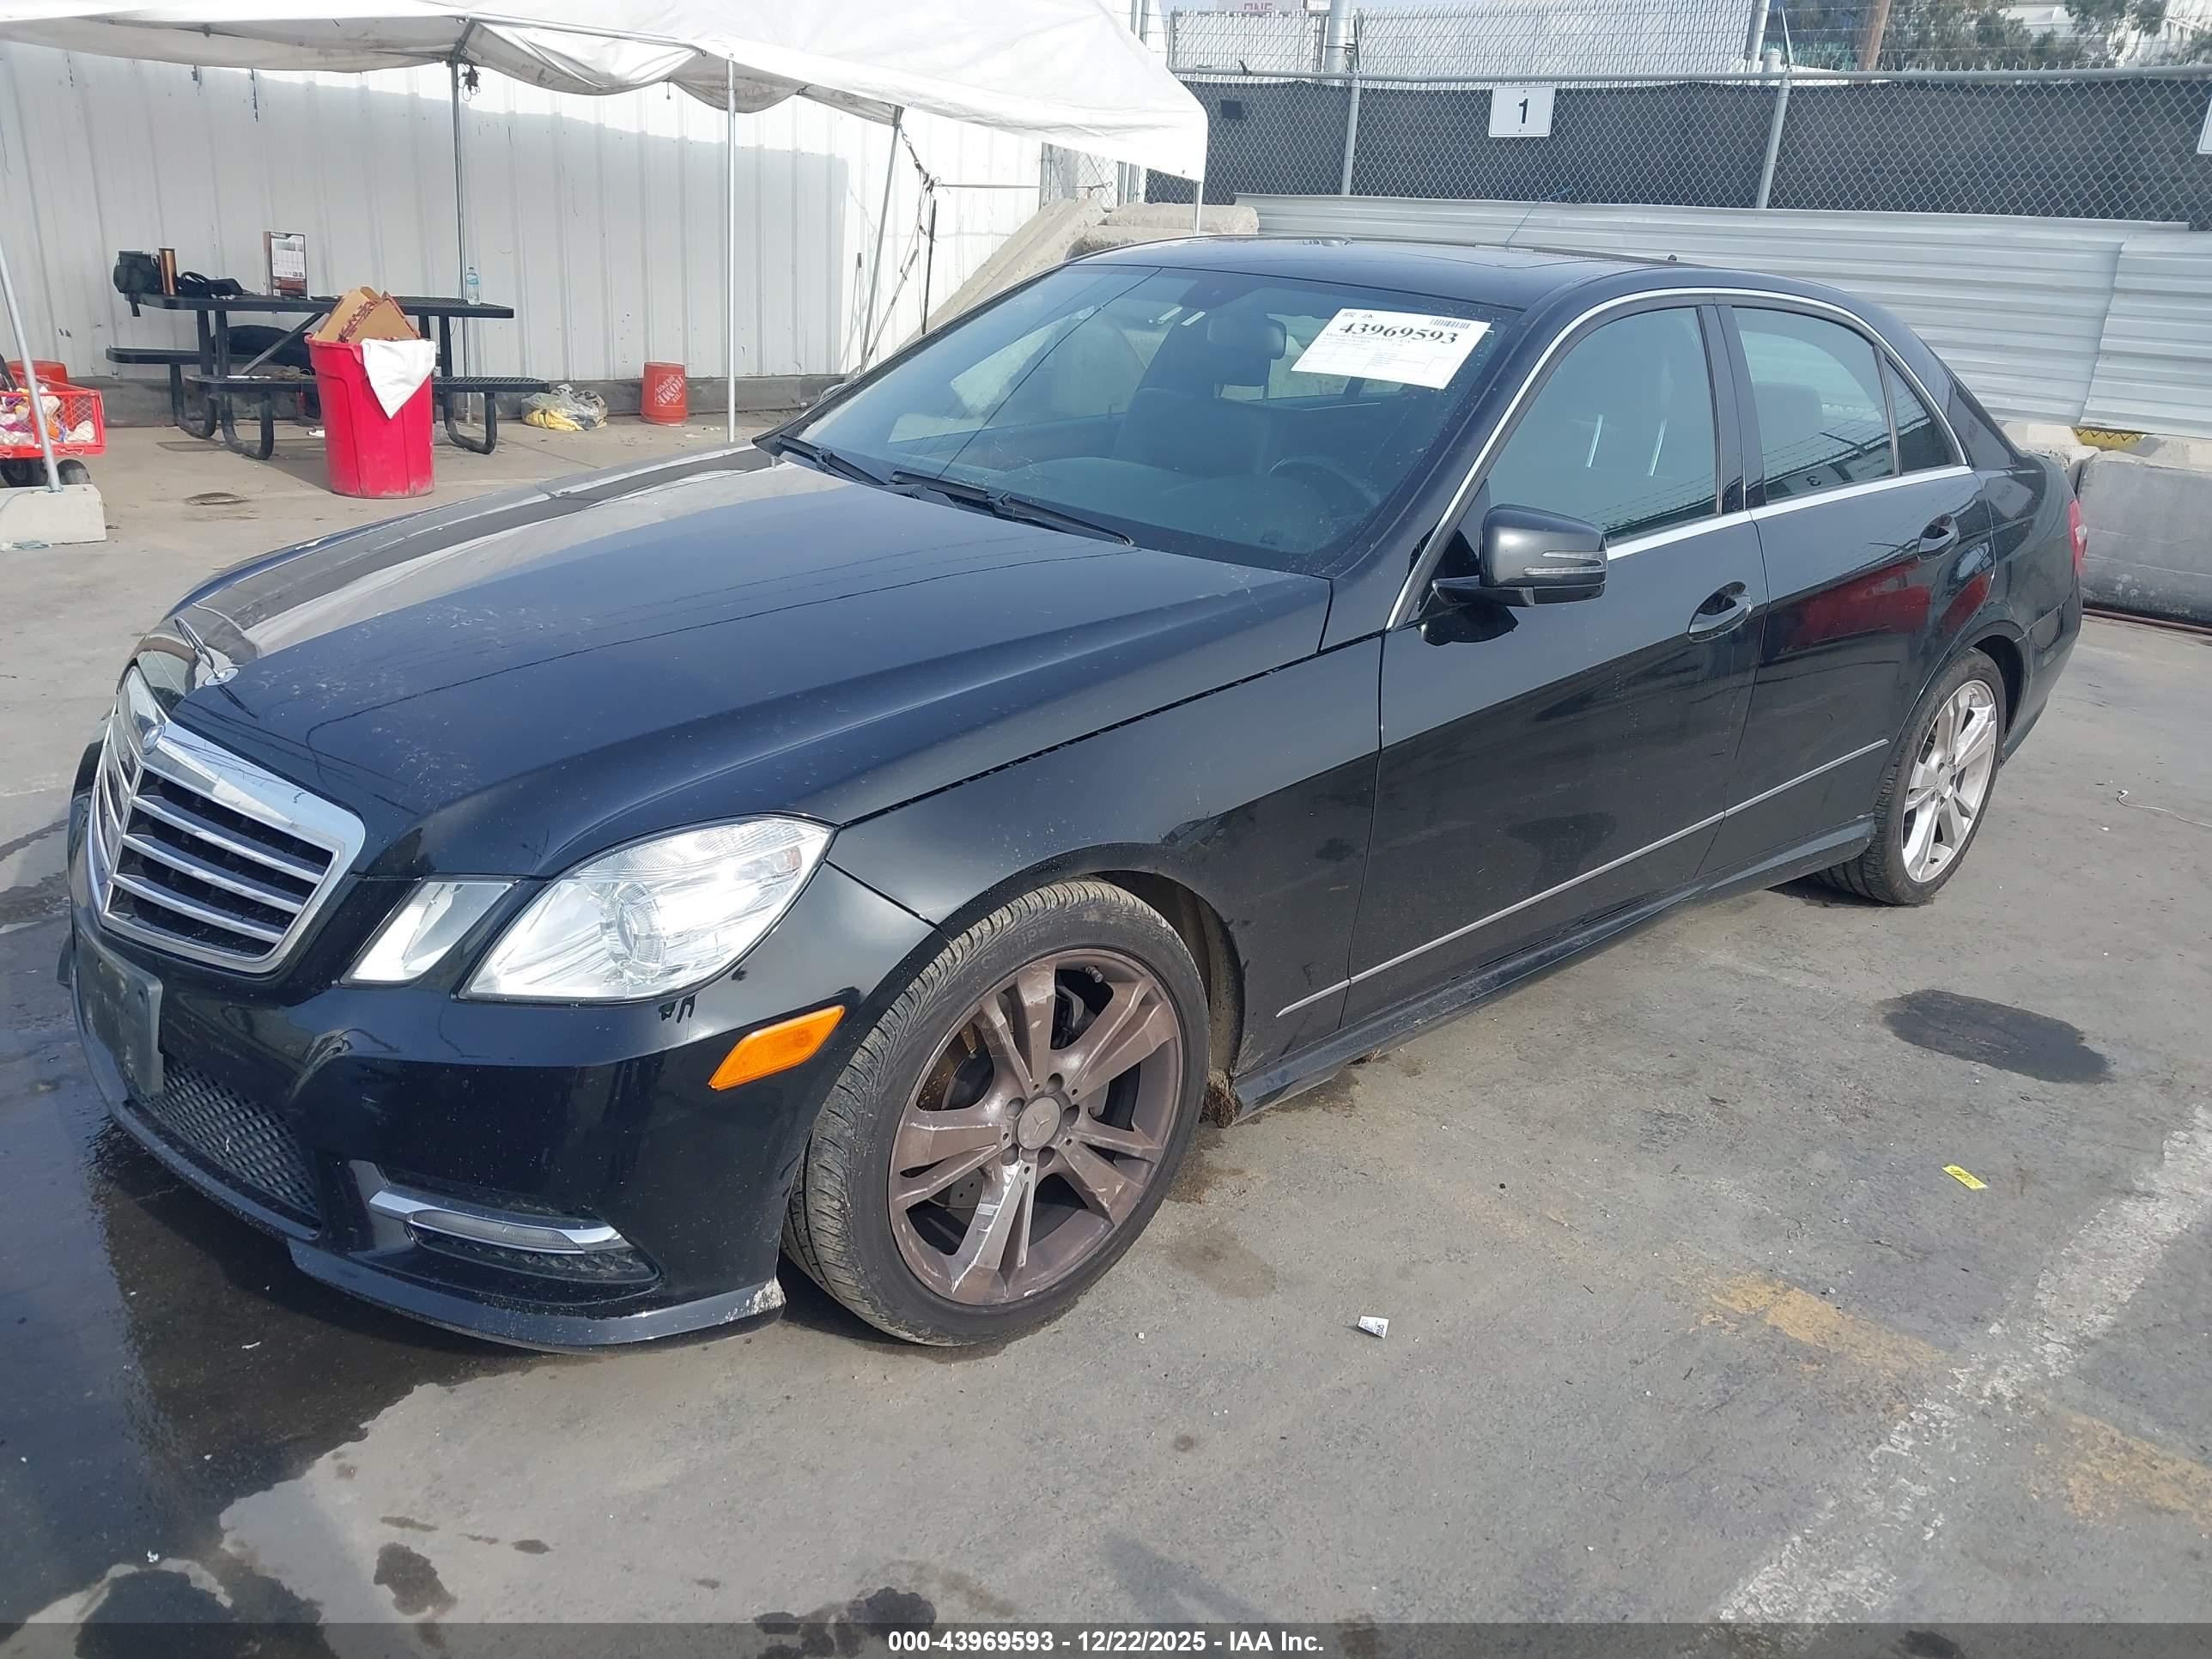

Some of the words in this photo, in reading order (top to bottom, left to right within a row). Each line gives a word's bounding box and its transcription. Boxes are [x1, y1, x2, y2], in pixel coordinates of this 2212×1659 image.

[1518, 98, 1528, 124] 1
[1340, 323, 1458, 343] 43969593
[657, 376, 684, 406] HOME
